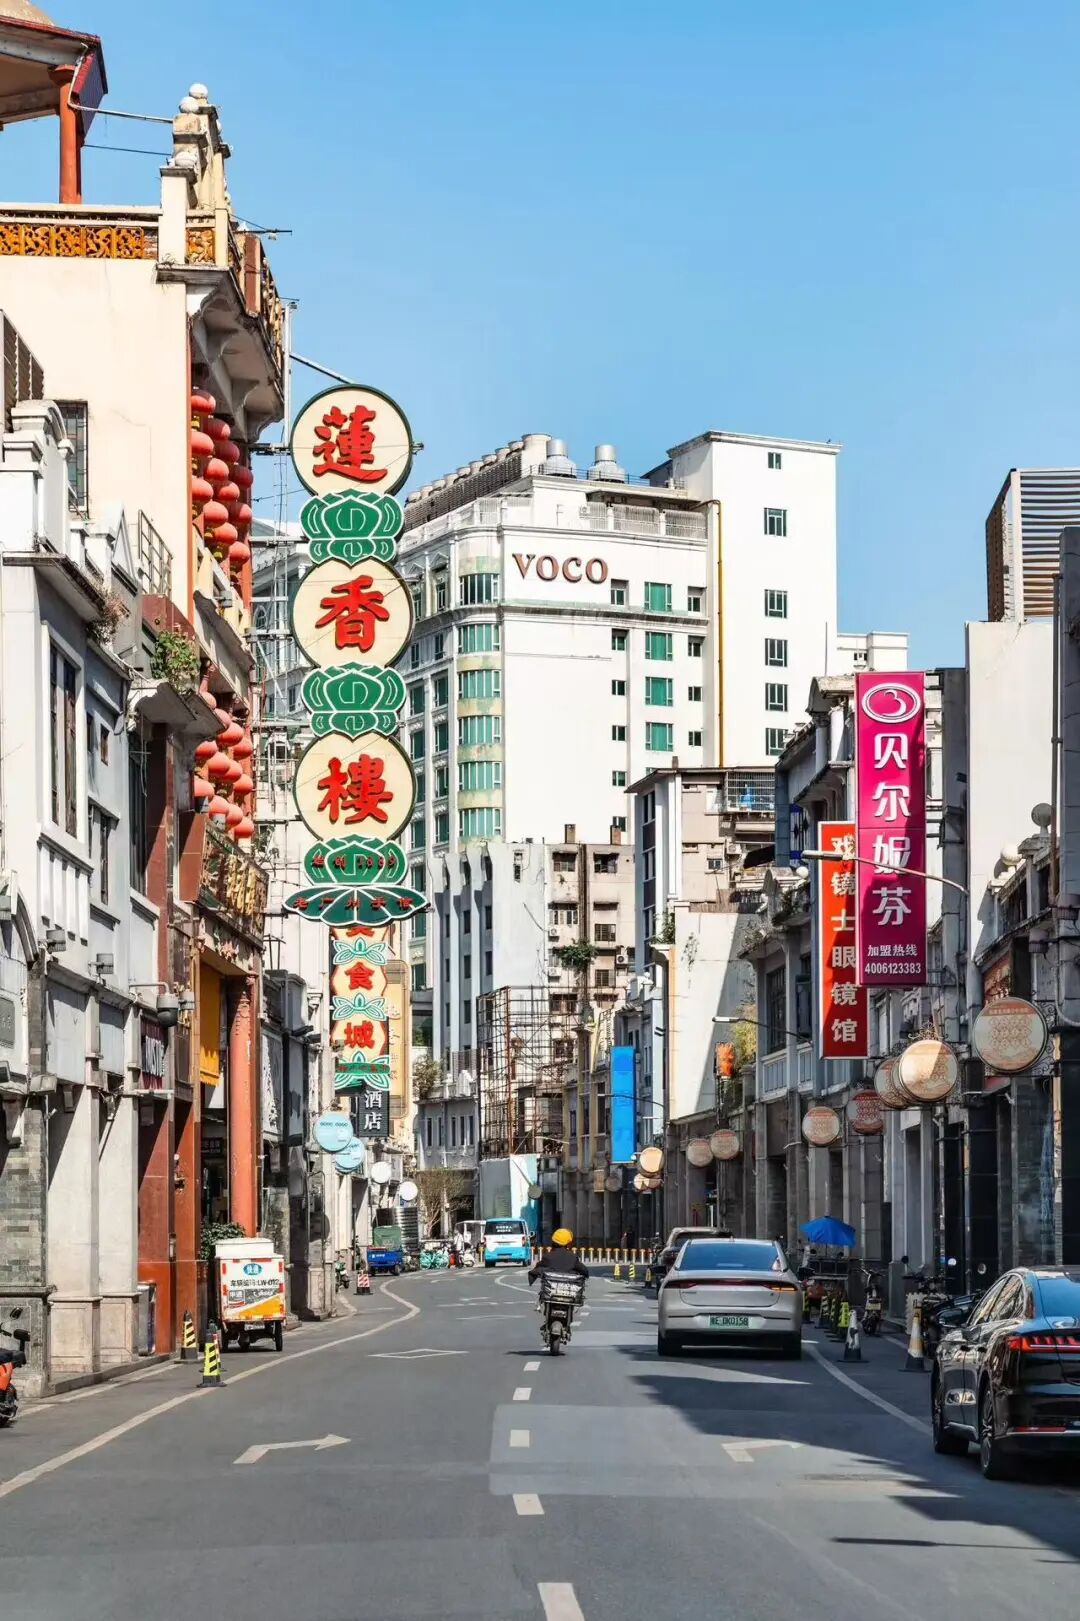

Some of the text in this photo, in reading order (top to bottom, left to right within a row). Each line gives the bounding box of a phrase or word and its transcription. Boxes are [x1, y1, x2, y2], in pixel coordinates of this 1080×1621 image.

[512, 553, 608, 584] VOCO
[313, 405, 393, 824] 蓮香樓
[872, 731, 912, 926] 贝尔妮芬
[864, 962, 922, 975] 4006123383
[867, 944, 918, 957] 加盟热线
[363, 1088, 383, 1131] 酒店
